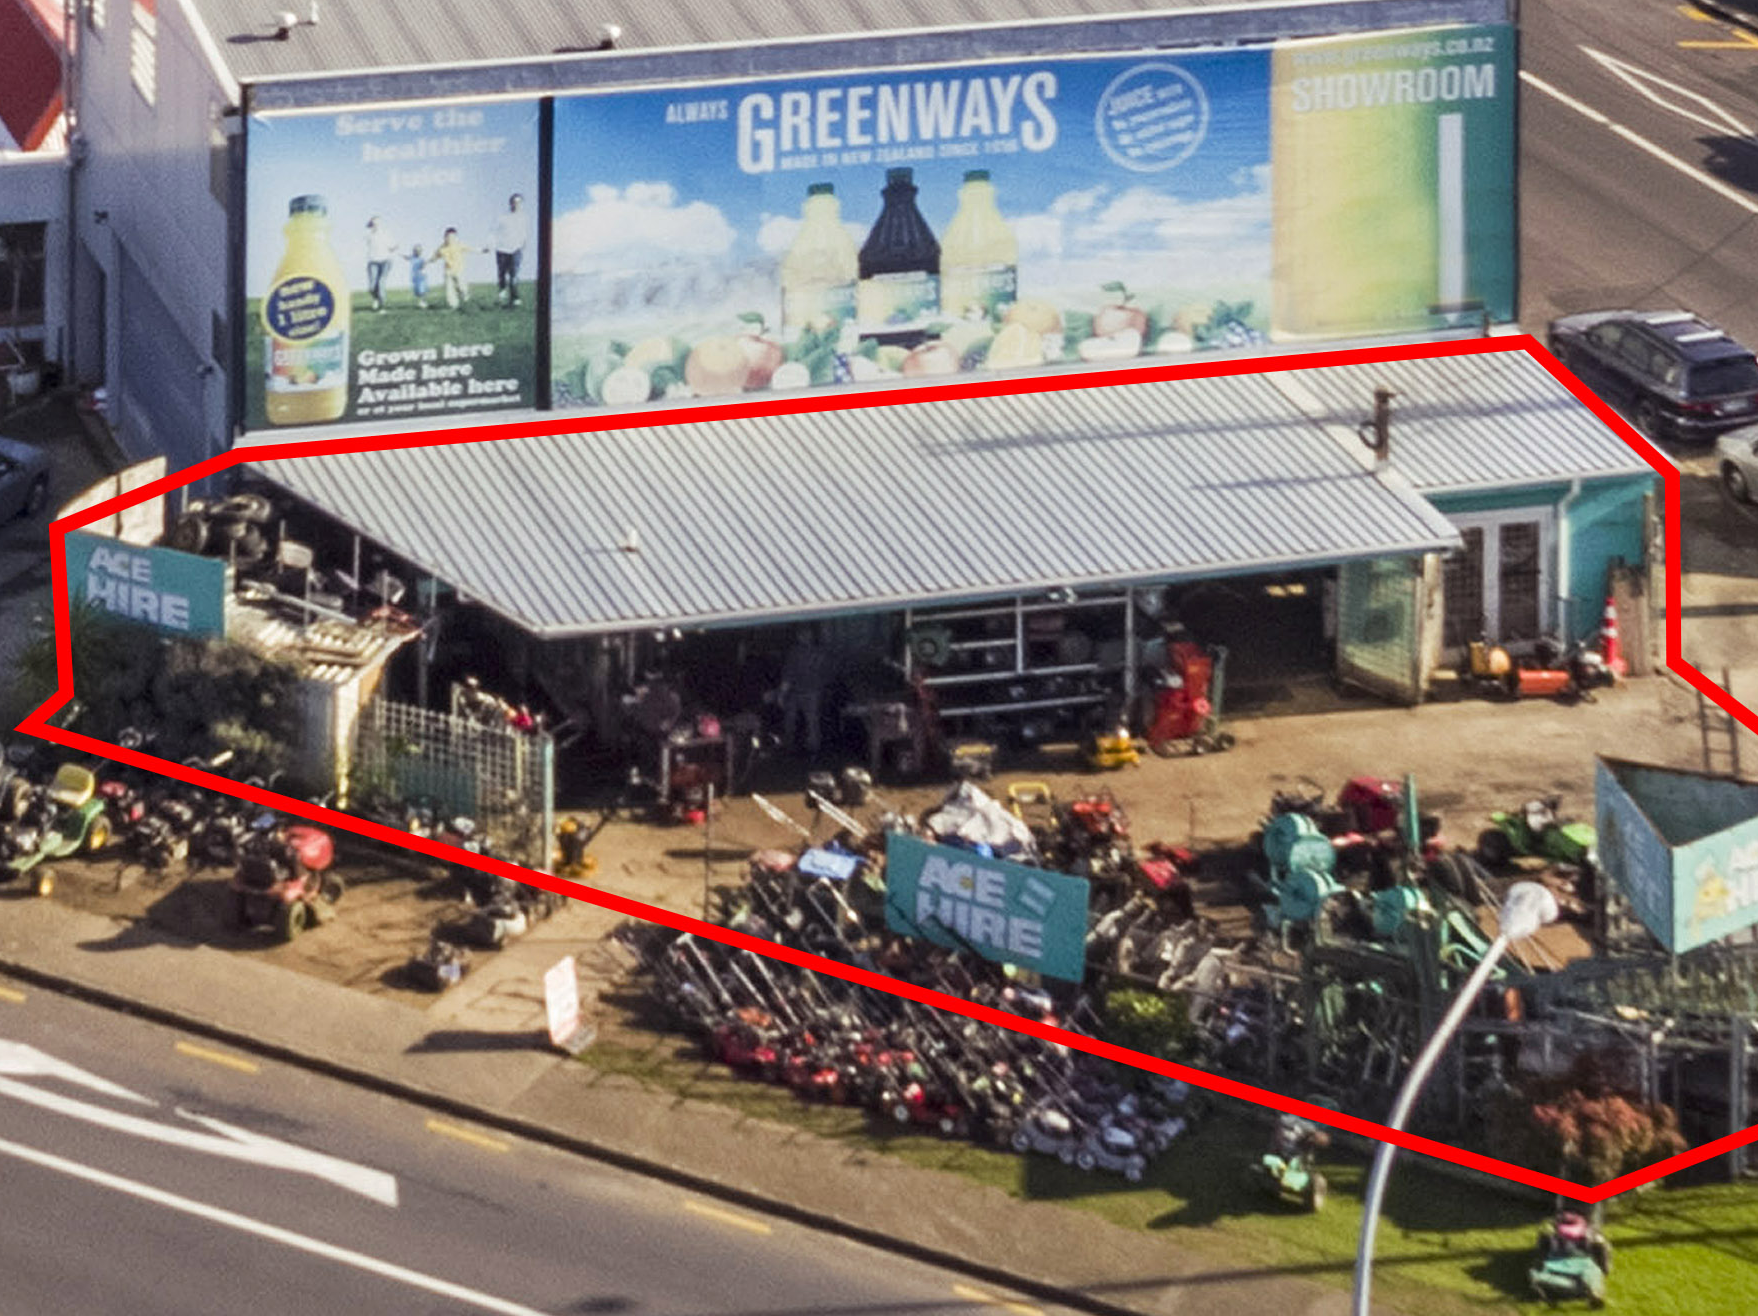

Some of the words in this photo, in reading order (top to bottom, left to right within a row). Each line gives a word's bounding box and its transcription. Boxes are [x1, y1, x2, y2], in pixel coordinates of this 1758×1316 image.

[1292, 63, 1496, 112] SHOWROOM
[335, 113, 423, 135] Serve
[432, 108, 484, 129] the
[665, 99, 729, 124] ALWAYS
[737, 71, 1058, 174] GREENWAYS
[362, 136, 507, 164] healthier
[841, 150, 871, 165] NEW
[357, 348, 438, 367] Grown
[444, 343, 494, 359] here
[357, 367, 417, 385] Made
[421, 363, 473, 380] here
[356, 380, 464, 404] Available
[467, 378, 519, 395] here
[88, 545, 152, 582] ACE
[86, 572, 190, 630] HIRE
[918, 855, 1006, 909] ACE
[915, 889, 1043, 958] HIRE
